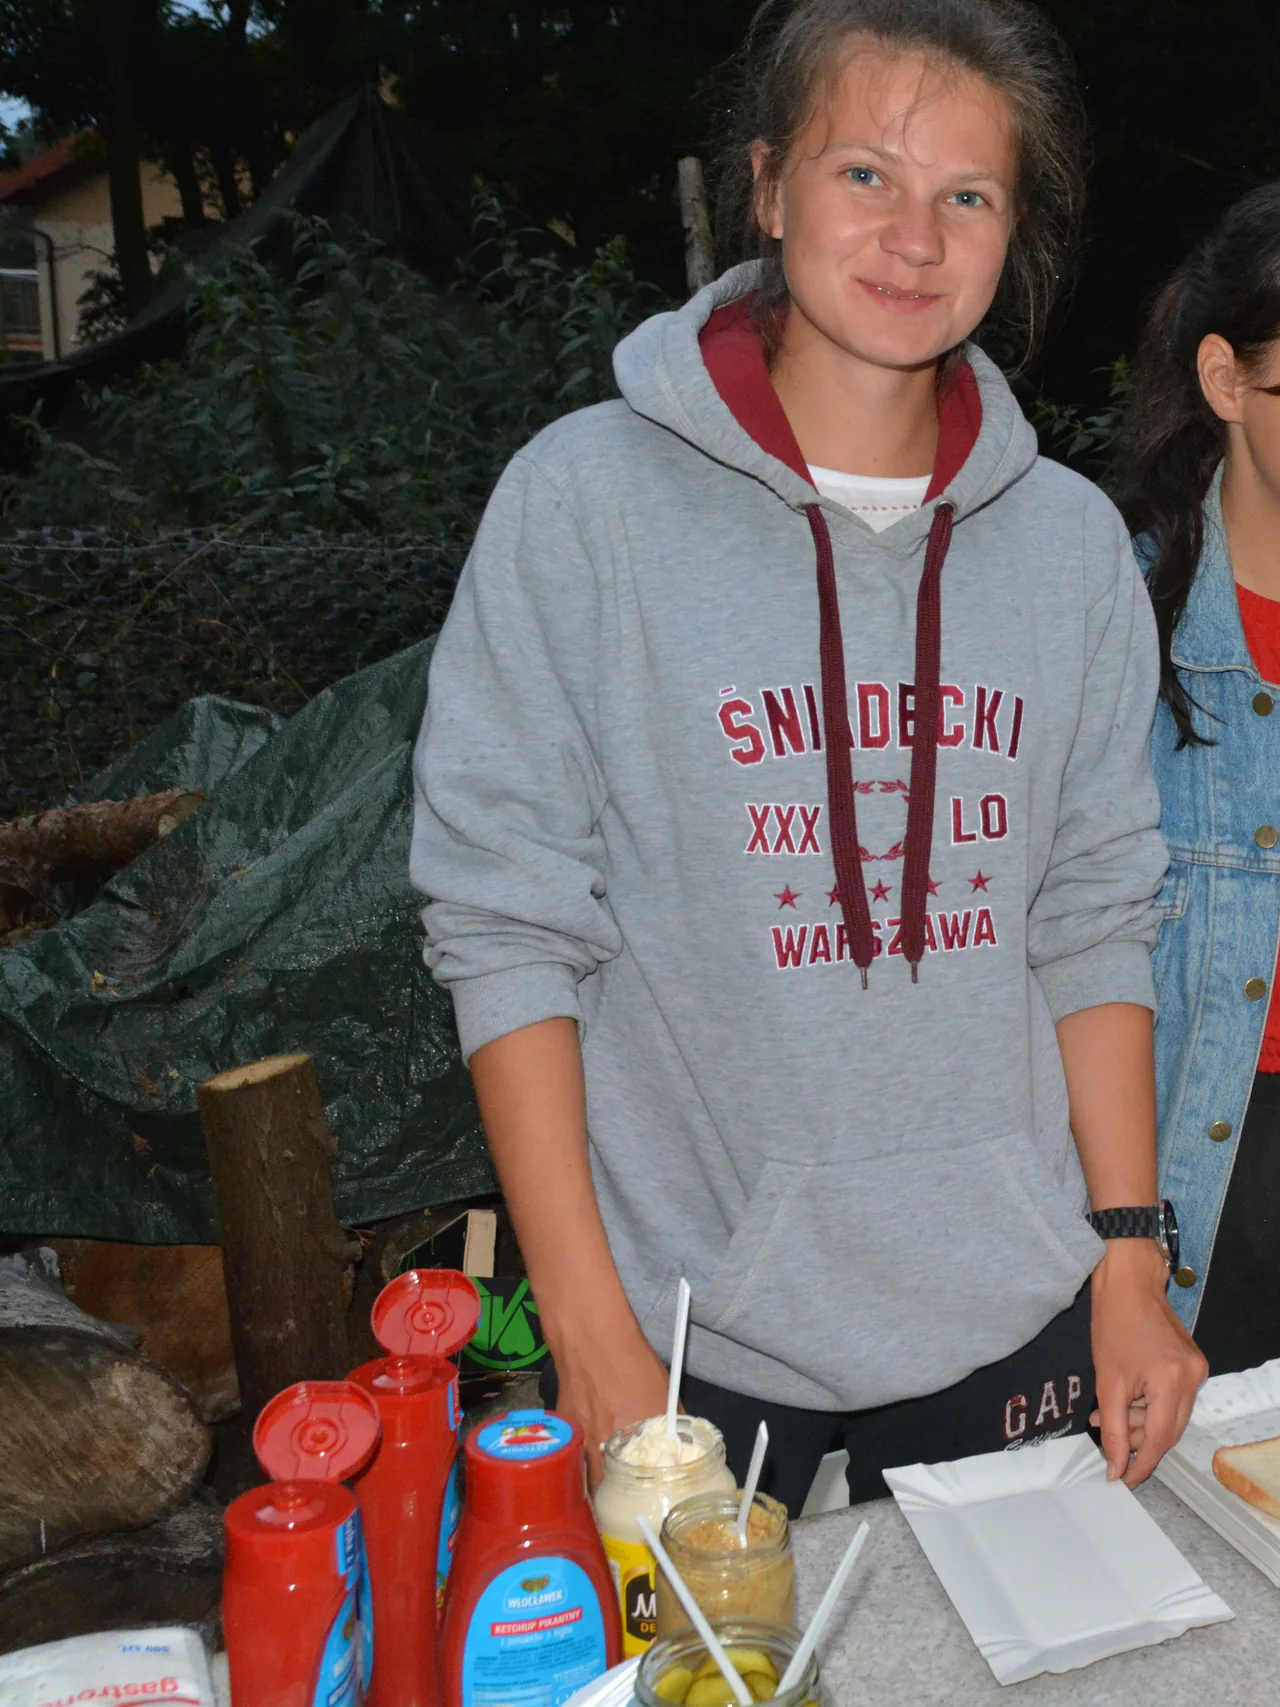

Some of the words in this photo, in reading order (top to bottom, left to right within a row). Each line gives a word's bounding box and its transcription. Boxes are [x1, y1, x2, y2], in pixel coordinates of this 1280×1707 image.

[717, 681, 1025, 767] ŚNIDECKI
[743, 802, 823, 856] XXX
[949, 792, 1010, 845] LO
[1003, 1375, 1082, 1439] GAP
[494, 1619, 537, 1635] KETCHUP
[538, 1608, 582, 1629] PIKANTNY
